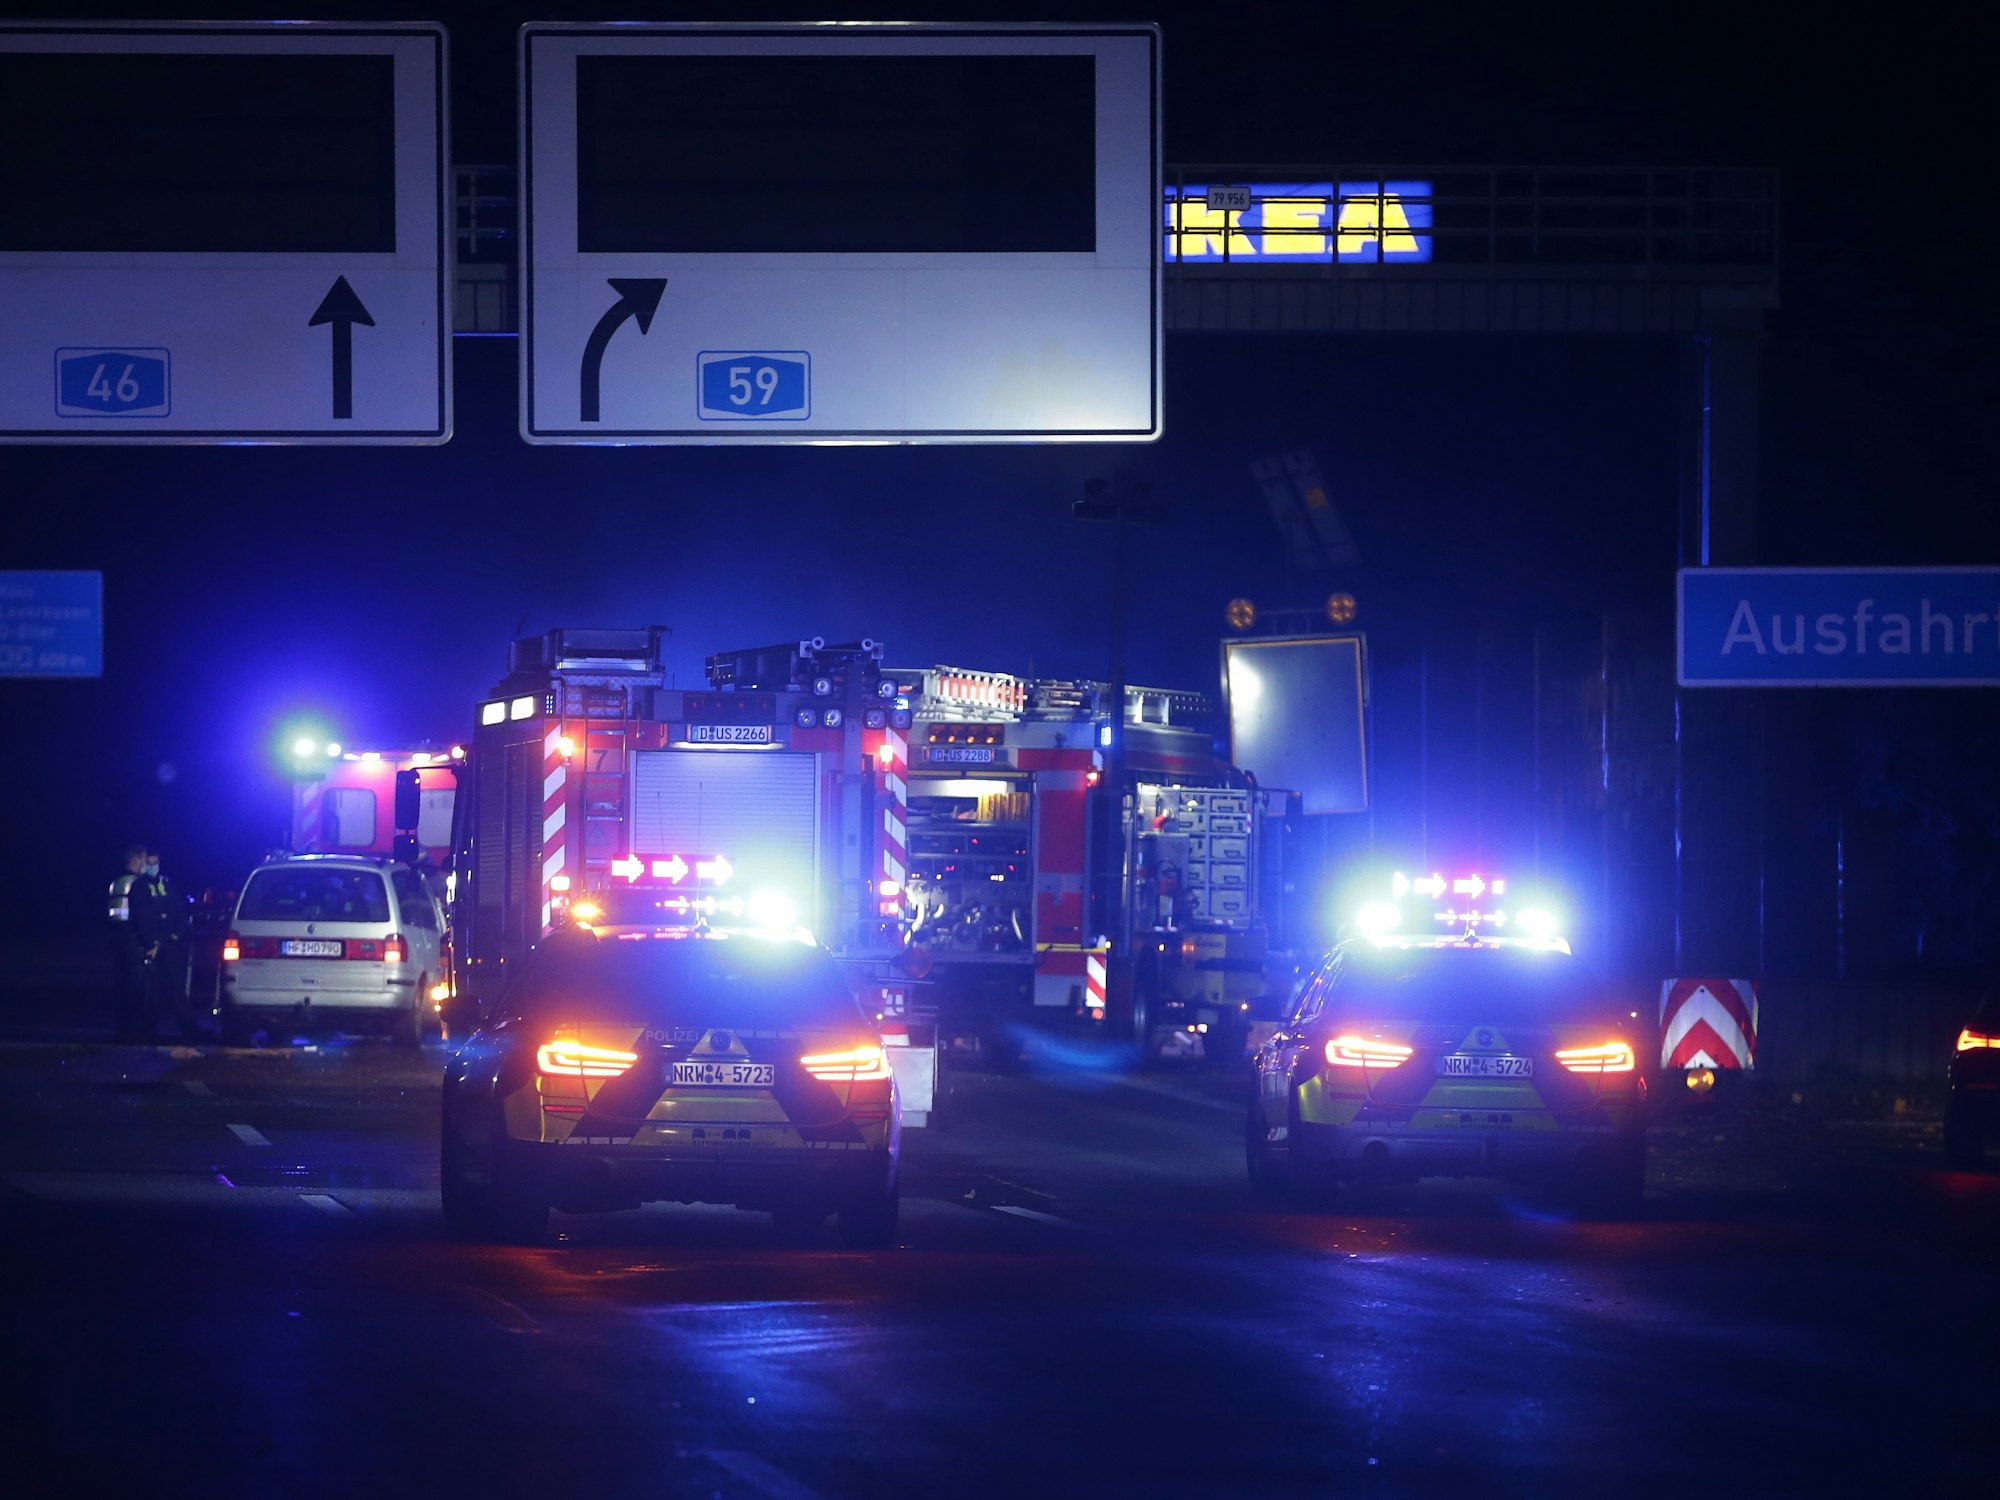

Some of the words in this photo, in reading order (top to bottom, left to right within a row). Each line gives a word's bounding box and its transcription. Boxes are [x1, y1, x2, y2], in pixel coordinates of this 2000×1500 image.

[1213, 192, 1245, 205] 79.956
[1168, 193, 1420, 256] KEA
[86, 363, 140, 402] 46
[728, 366, 779, 406] 59
[1720, 598, 2000, 655] Ausfahr
[699, 727, 708, 740] D
[716, 727, 732, 740] US
[734, 727, 766, 740] 2266
[965, 750, 990, 761] 2288
[645, 1029, 699, 1042] POLIZEI
[673, 1064, 705, 1082] NRW
[714, 1065, 774, 1084] 4-5723
[1444, 1058, 1472, 1074] NRW
[1480, 1058, 1532, 1075] 4-5724
